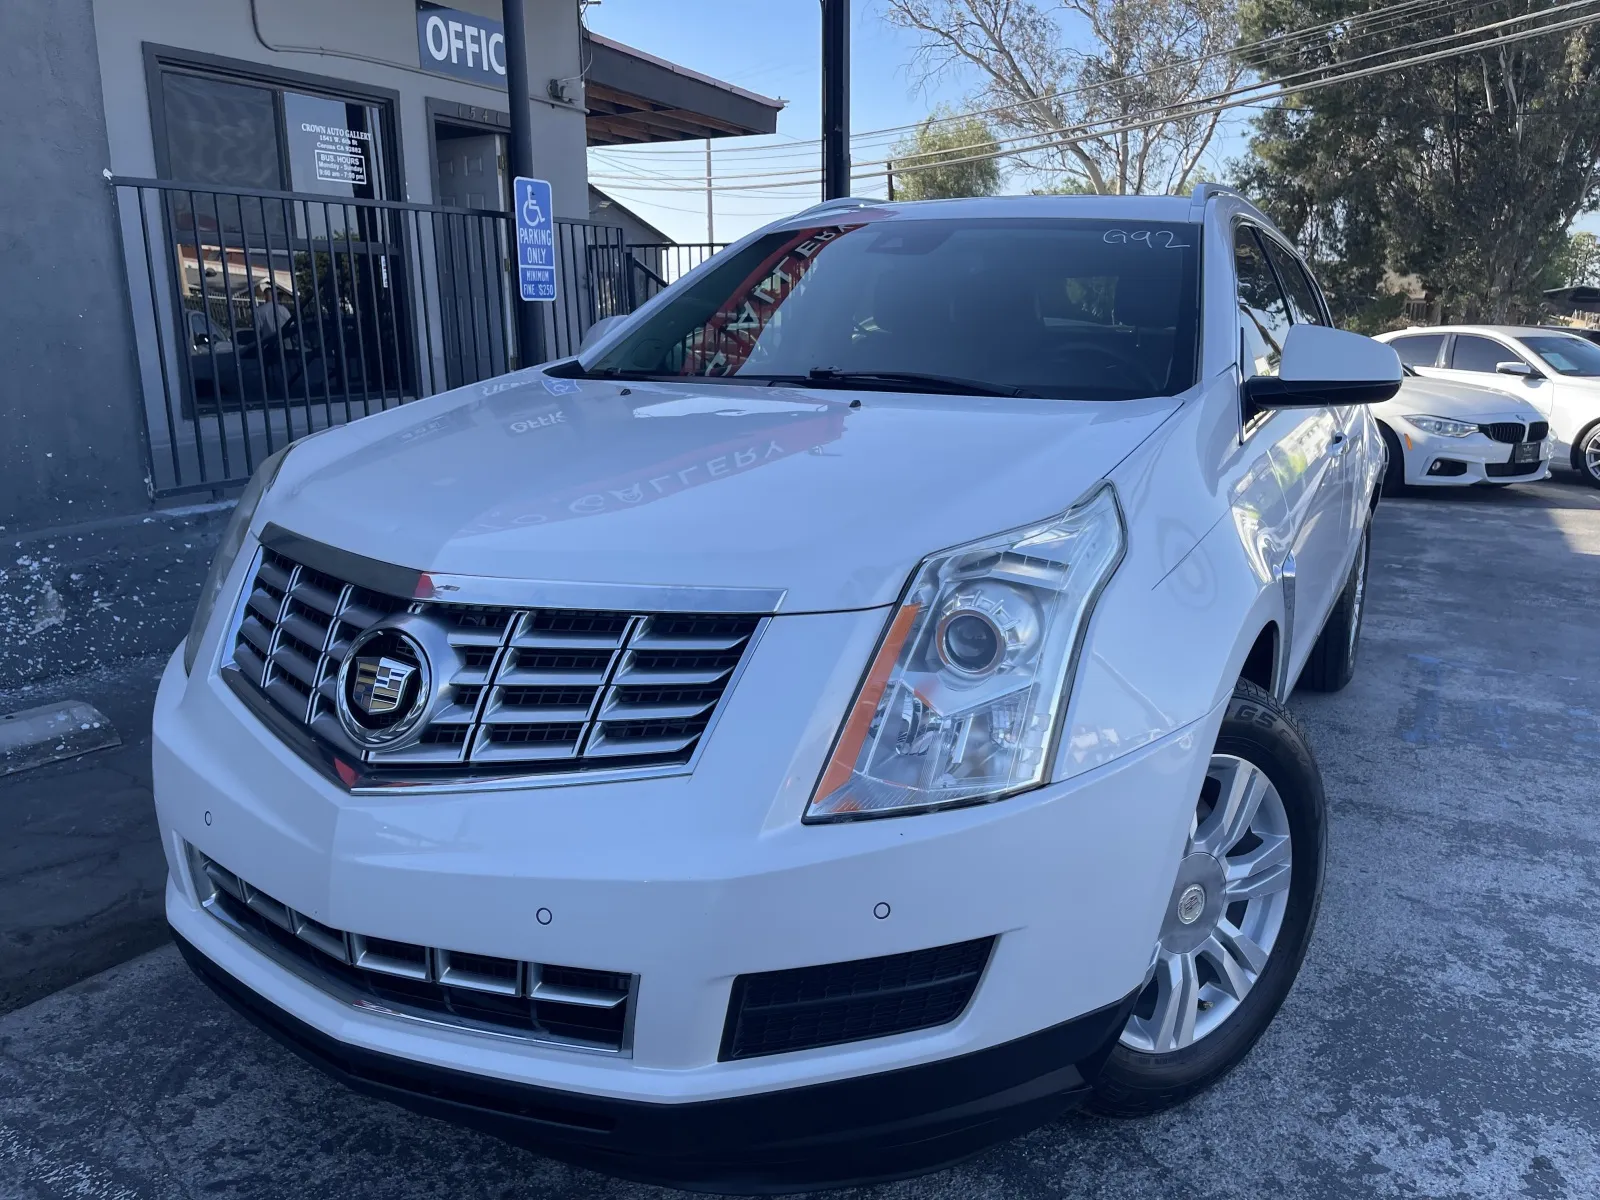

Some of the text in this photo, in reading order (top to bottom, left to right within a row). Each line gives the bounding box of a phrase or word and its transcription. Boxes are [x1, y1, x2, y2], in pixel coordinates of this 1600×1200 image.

[426, 15, 506, 75] OFFIC
[301, 123, 371, 140] CROWN AUTO GALLERY
[318, 161, 340, 170] Monday
[344, 164, 362, 173] Sunday
[336, 156, 360, 166] HOURS
[520, 228, 552, 246] PARKING
[527, 246, 546, 264] ONLY
[526, 270, 549, 282] MINIMUM
[524, 284, 554, 296] FINE $250
